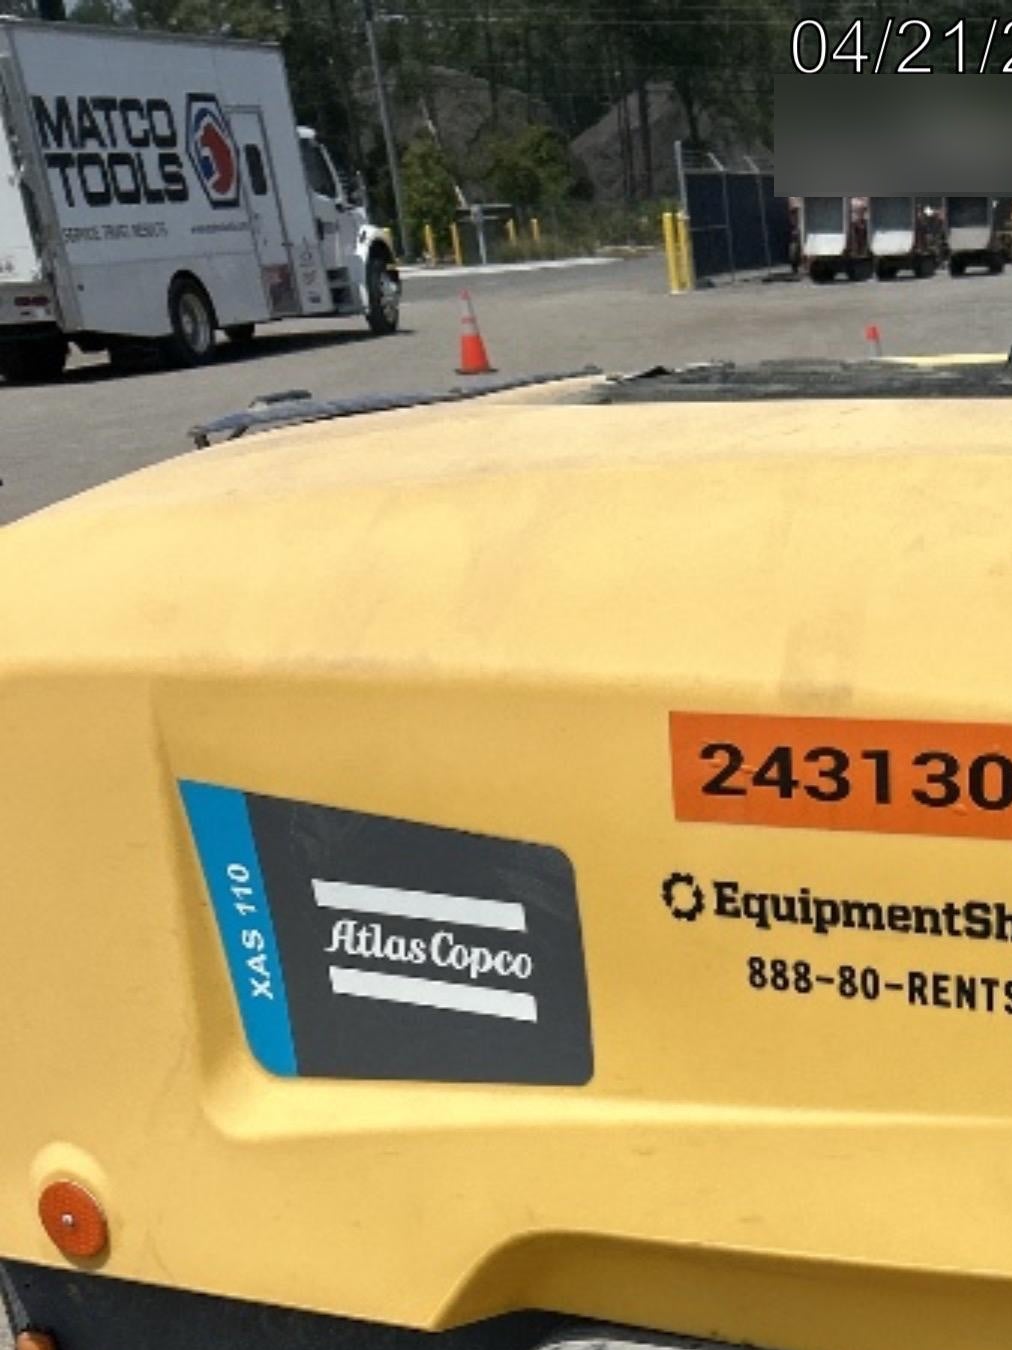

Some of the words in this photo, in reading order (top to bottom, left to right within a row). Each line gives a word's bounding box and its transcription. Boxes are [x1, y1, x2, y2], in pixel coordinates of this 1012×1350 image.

[31, 96, 177, 148] MATCO
[45, 152, 189, 207] TOOLS
[226, 863, 257, 916] 110
[242, 929, 274, 999] XAS
[323, 918, 426, 964] Atlas
[430, 930, 533, 979] Copco
